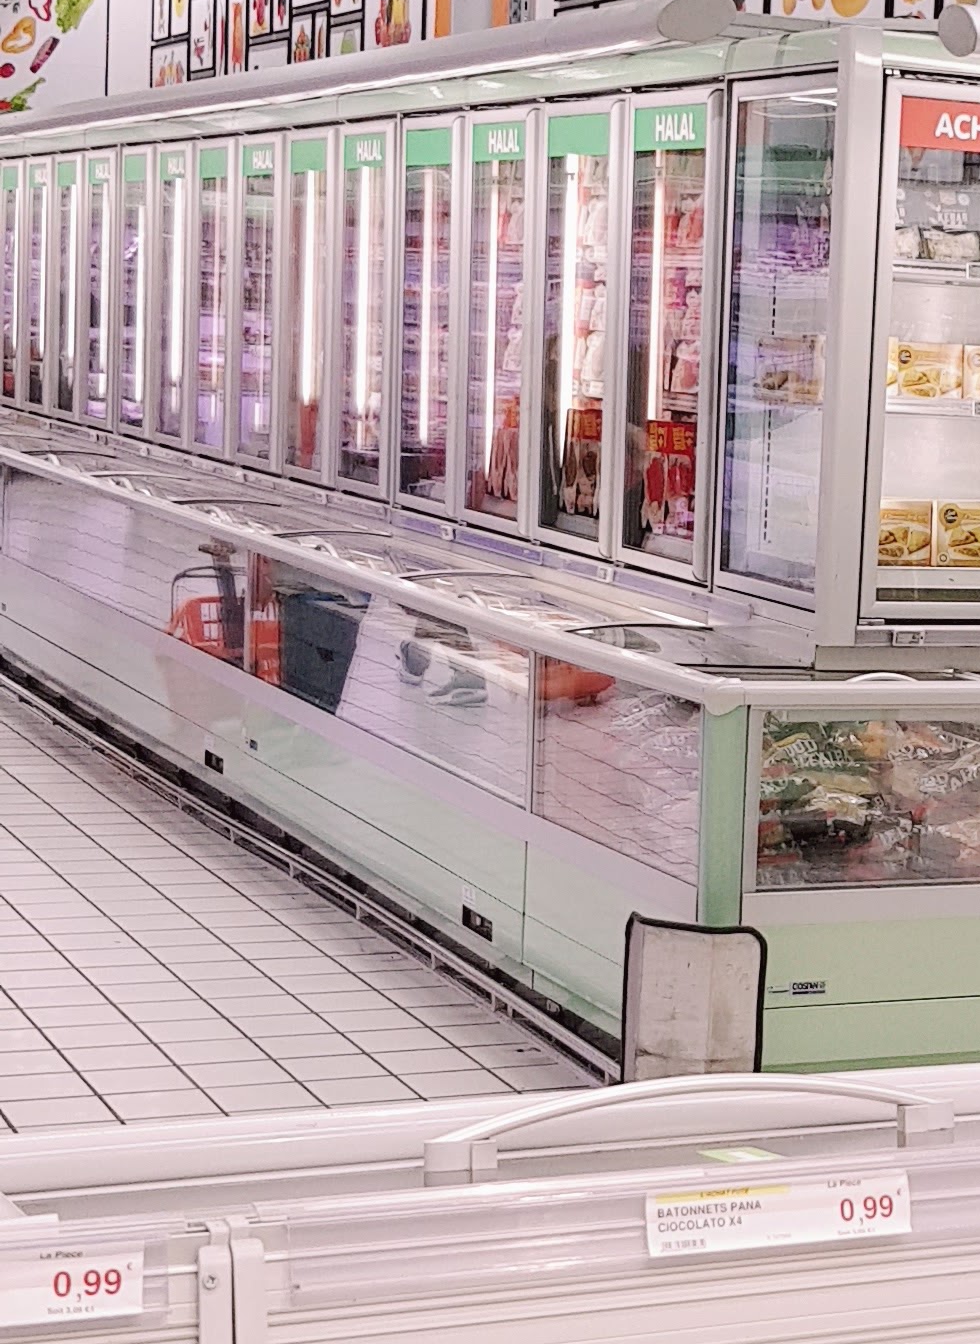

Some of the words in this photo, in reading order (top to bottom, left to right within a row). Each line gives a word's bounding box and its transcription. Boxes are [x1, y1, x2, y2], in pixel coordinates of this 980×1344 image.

[655, 112, 695, 141] HALAL
[357, 140, 382, 161] HALAL
[488, 128, 519, 154] HALAL
[827, 1180, 837, 1189] La
[657, 1202, 727, 1218] BATONNETS
[731, 1200, 761, 1211] PANA
[840, 1195, 893, 1225] 0,99
[658, 1218, 726, 1233] CIOCOLATO
[729, 1216, 743, 1227] X4
[54, 1269, 121, 1302] 0,99
